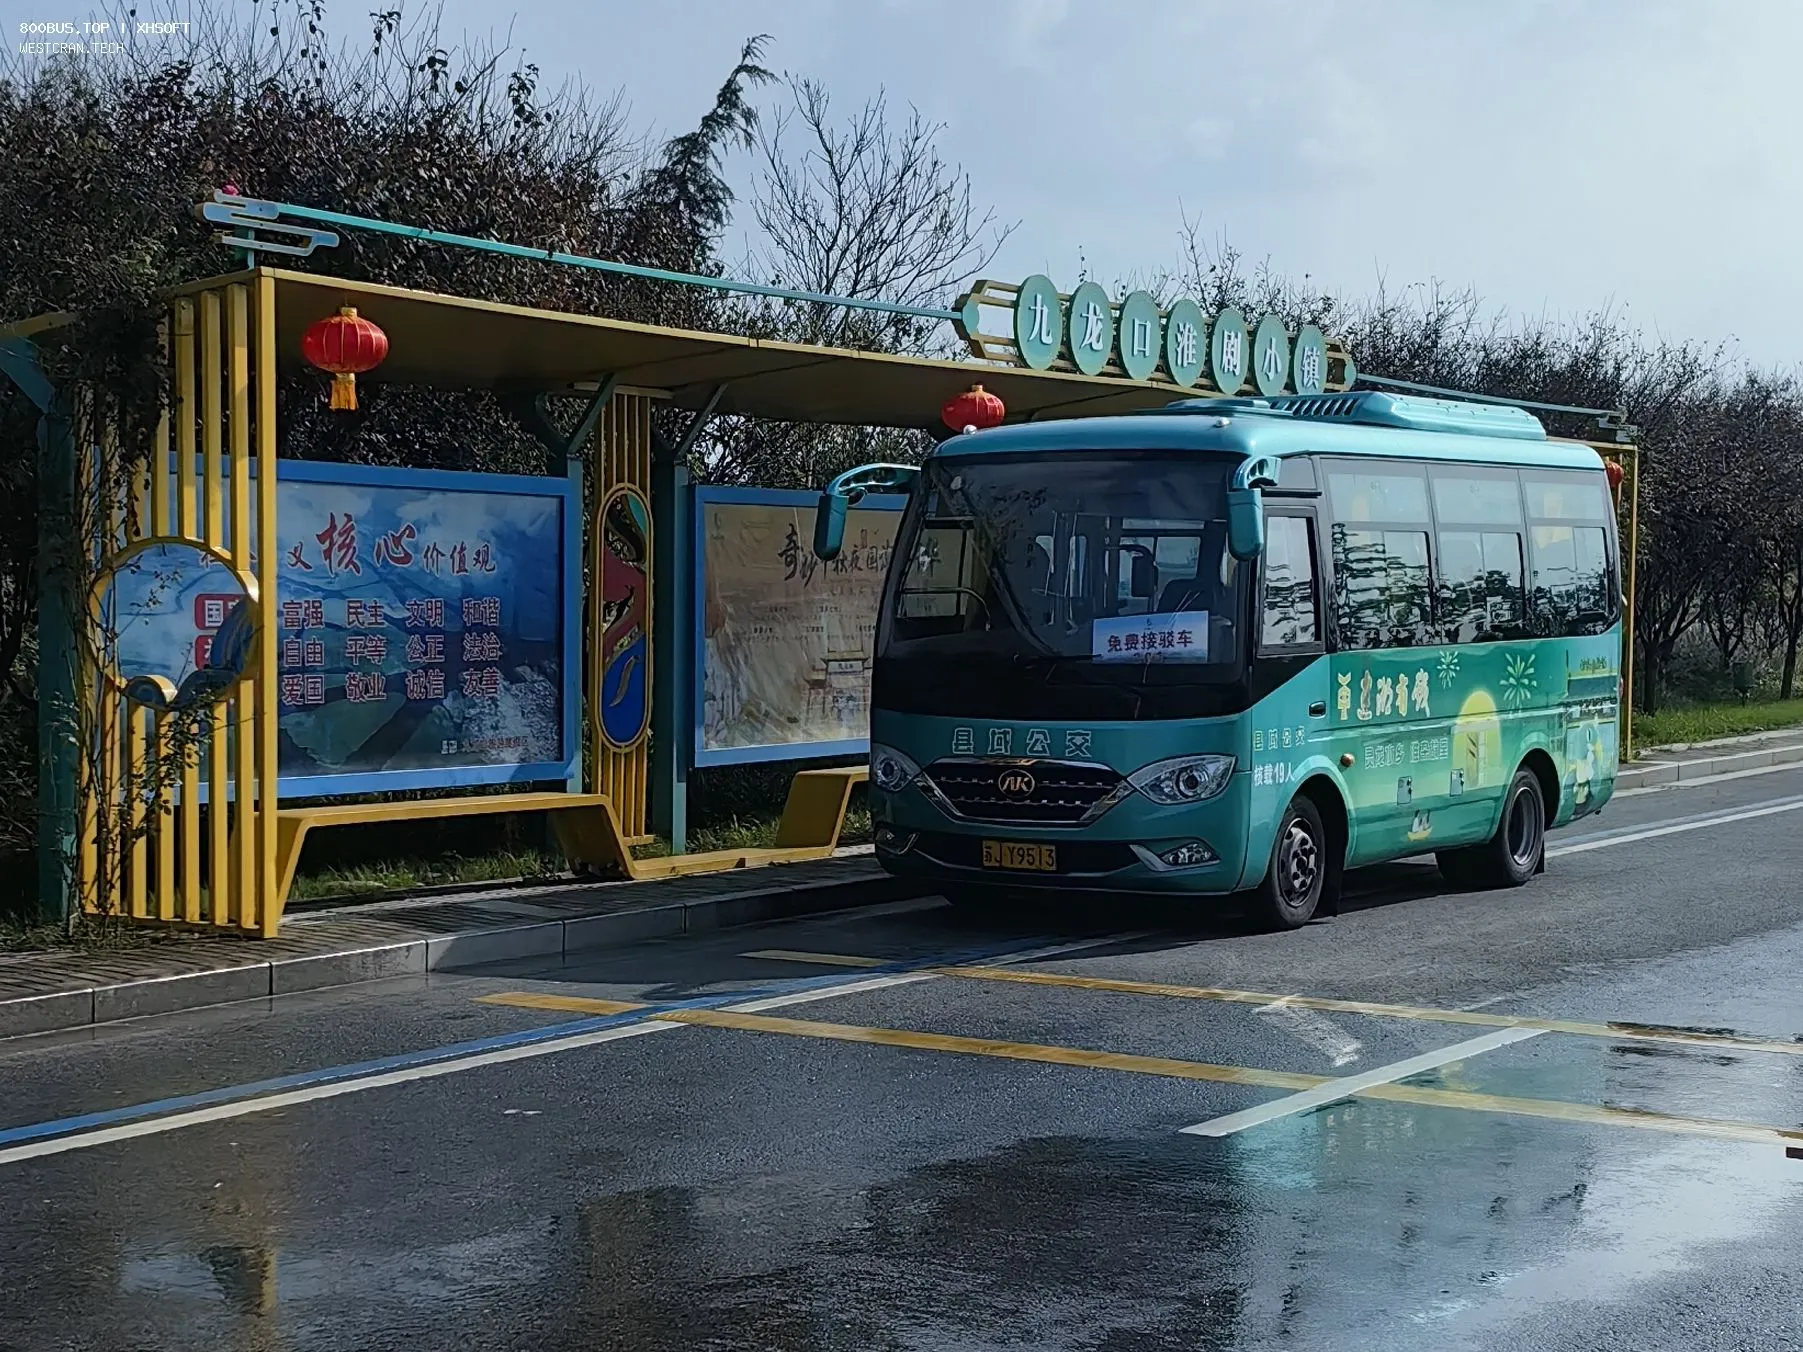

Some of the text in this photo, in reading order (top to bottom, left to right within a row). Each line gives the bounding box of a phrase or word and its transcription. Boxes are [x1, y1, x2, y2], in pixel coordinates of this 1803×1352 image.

[1028, 293, 1321, 389] 九龙口淮剧小镇
[201, 512, 497, 576] 义核心价值观
[283, 599, 324, 629] 富强
[346, 599, 387, 628] 民主
[406, 597, 445, 627] 文明
[463, 597, 500, 626] 和谐
[283, 632, 502, 666] 自由 平等 公正 法治
[1107, 629, 1194, 653] 免费接驳车
[282, 667, 500, 705] 爱国 敬业 诚信 友善
